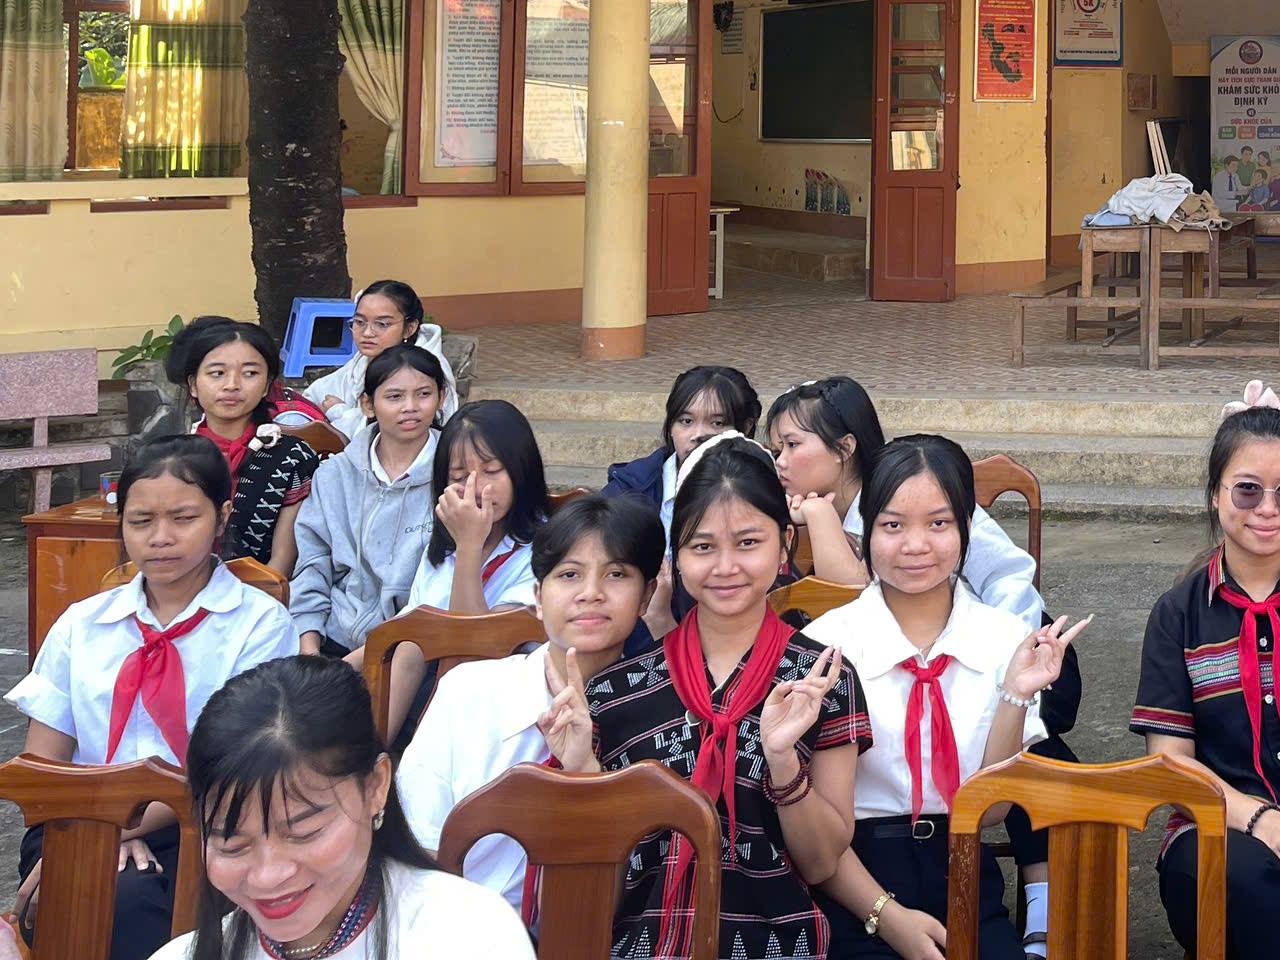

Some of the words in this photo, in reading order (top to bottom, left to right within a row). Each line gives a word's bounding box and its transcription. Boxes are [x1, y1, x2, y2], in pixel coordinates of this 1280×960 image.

[1217, 85, 1242, 95] KHÁM
[1244, 85, 1260, 95] SỨC
[1234, 97, 1255, 107] ĐỊNH
